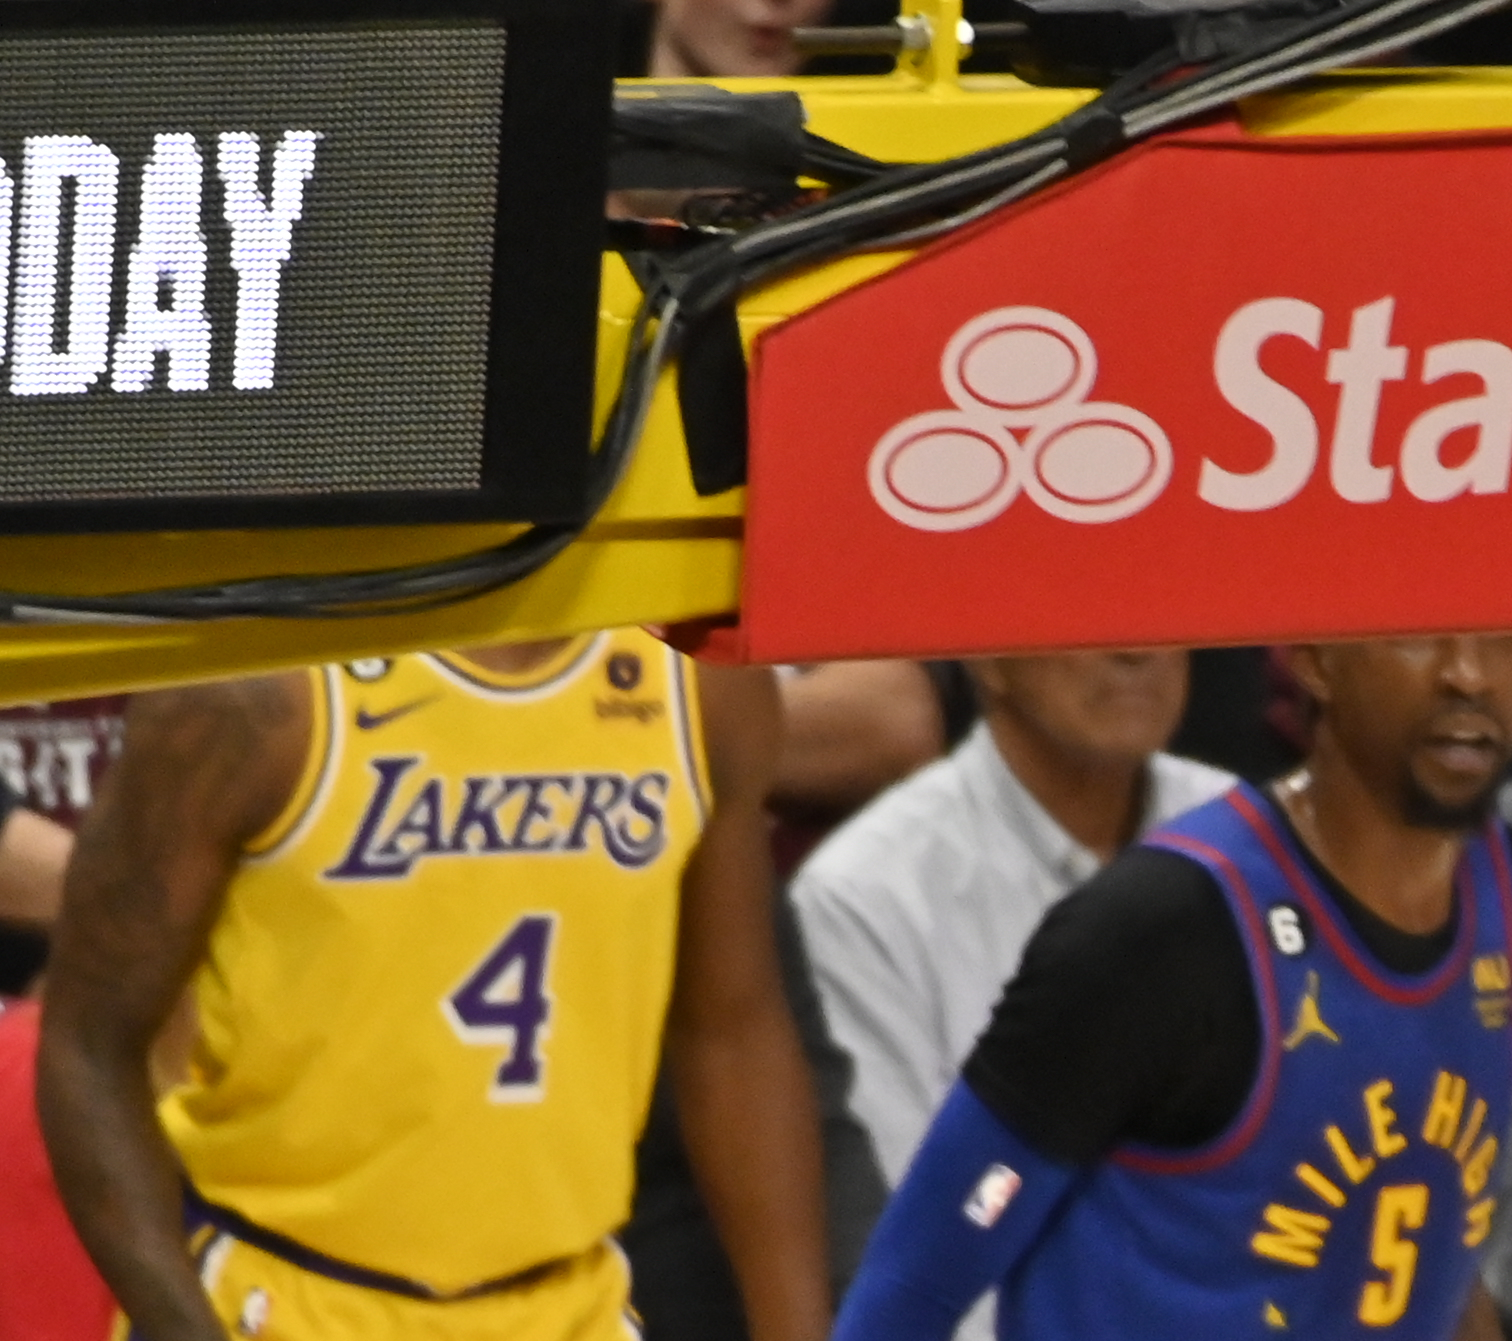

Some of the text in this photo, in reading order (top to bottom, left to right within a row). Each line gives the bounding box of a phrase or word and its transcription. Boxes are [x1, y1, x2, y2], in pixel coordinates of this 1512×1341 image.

[0, 130, 323, 394] DAY
[319, 754, 671, 880] LAKERS
[439, 912, 558, 1103] 4
[1268, 905, 1305, 956] 6
[1250, 1079, 1407, 1268] MILE
[1357, 1182, 1429, 1327] 5
